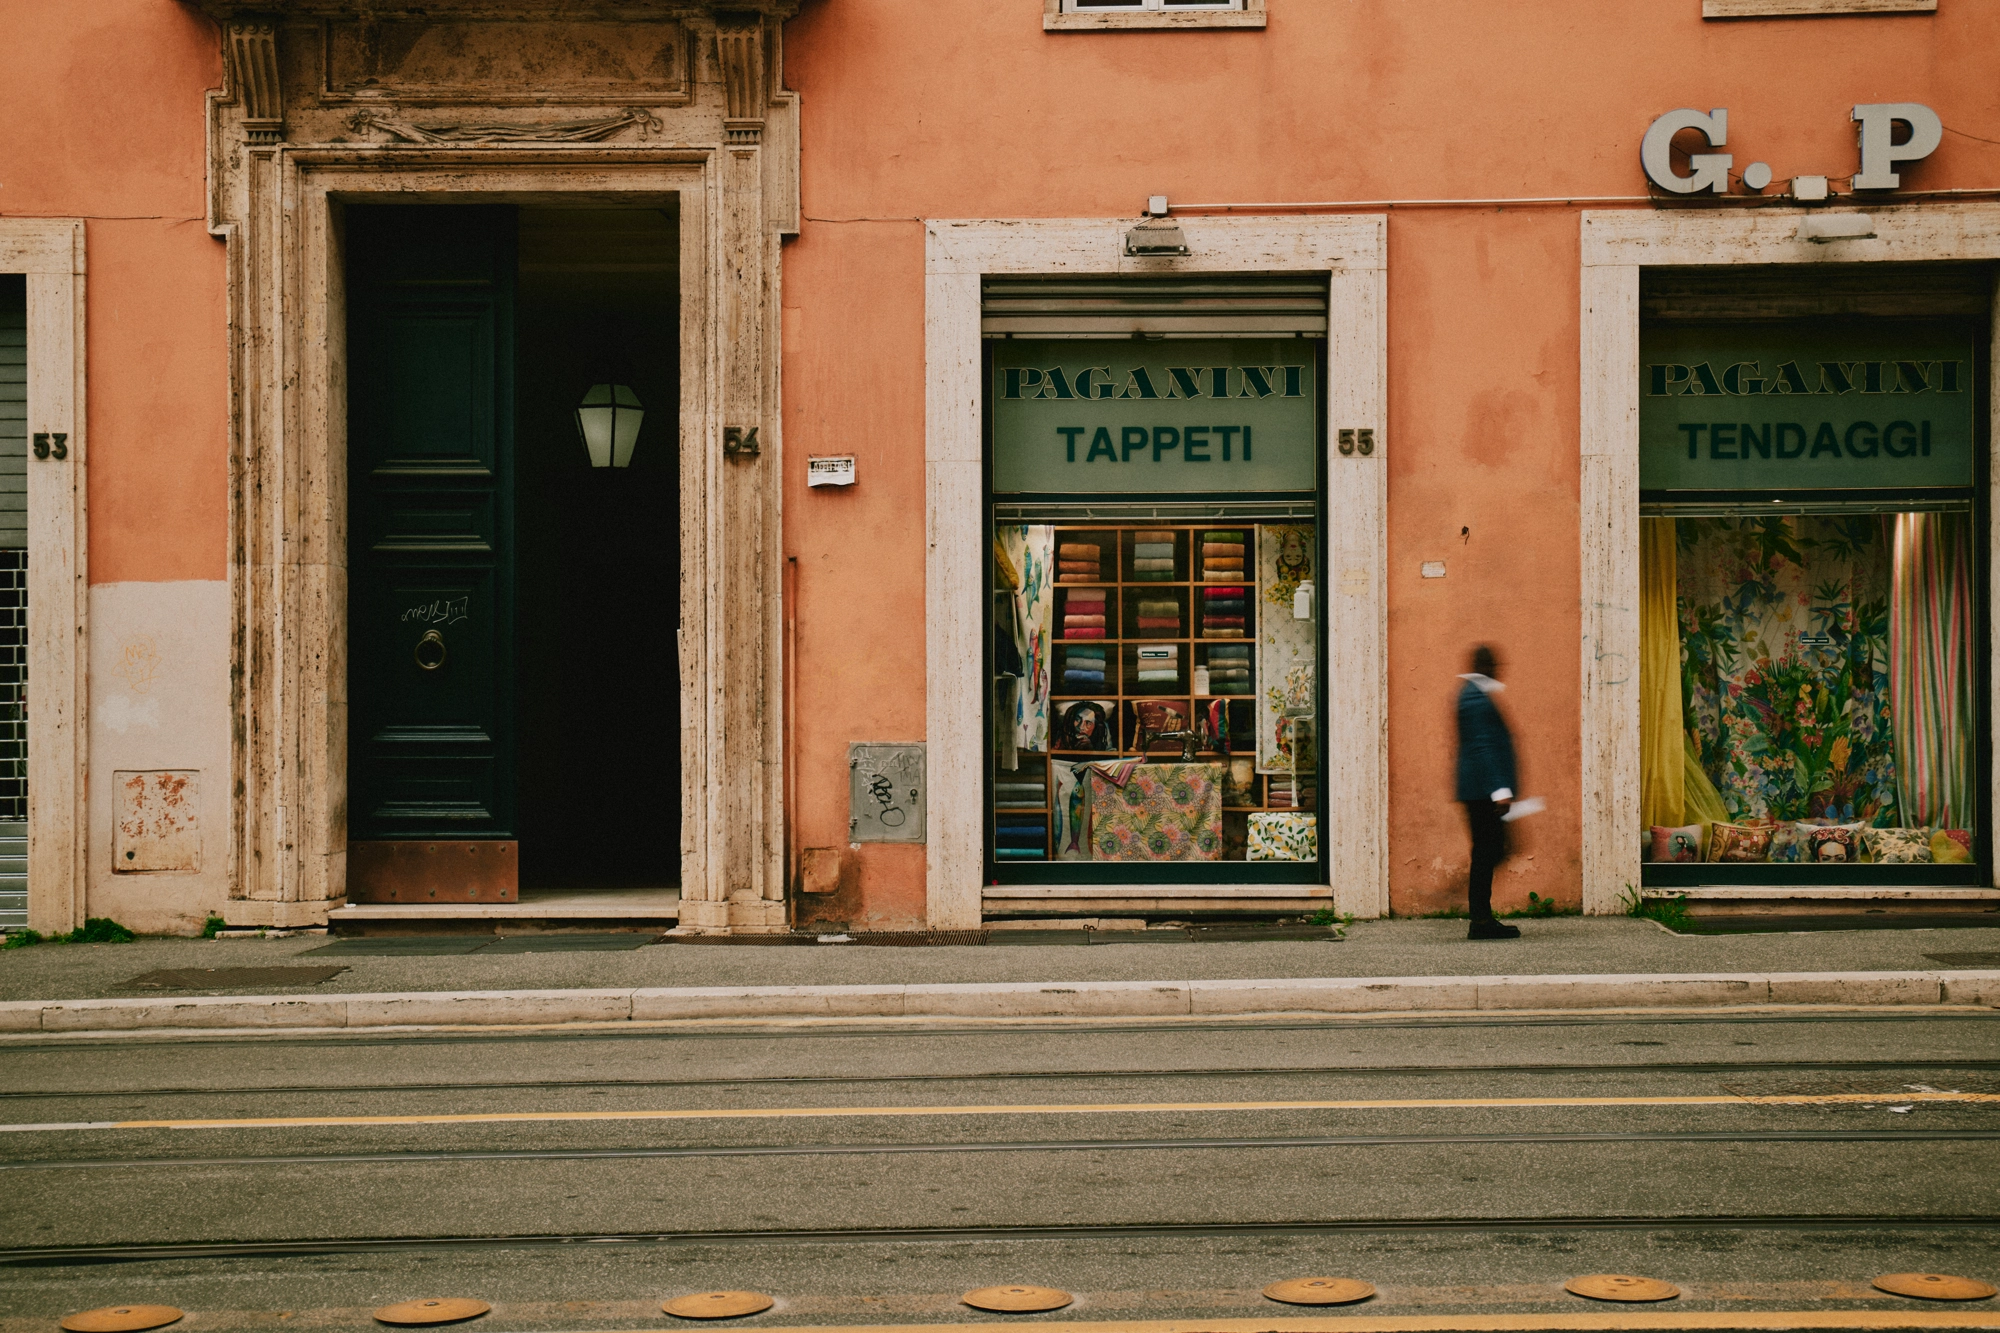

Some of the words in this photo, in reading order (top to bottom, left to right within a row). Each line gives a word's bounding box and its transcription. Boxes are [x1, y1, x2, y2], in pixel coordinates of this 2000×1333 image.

[1641, 108, 1772, 194] G.
[1850, 103, 1942, 191] P
[1000, 365, 1305, 400] PAGANINI
[1646, 360, 1963, 397] PAGANINI
[33, 432, 68, 459] 53
[723, 427, 759, 453] 54
[1057, 425, 1252, 463] TAPPETI
[1338, 429, 1374, 456] 55
[1678, 420, 1931, 460] TENDAGGI
